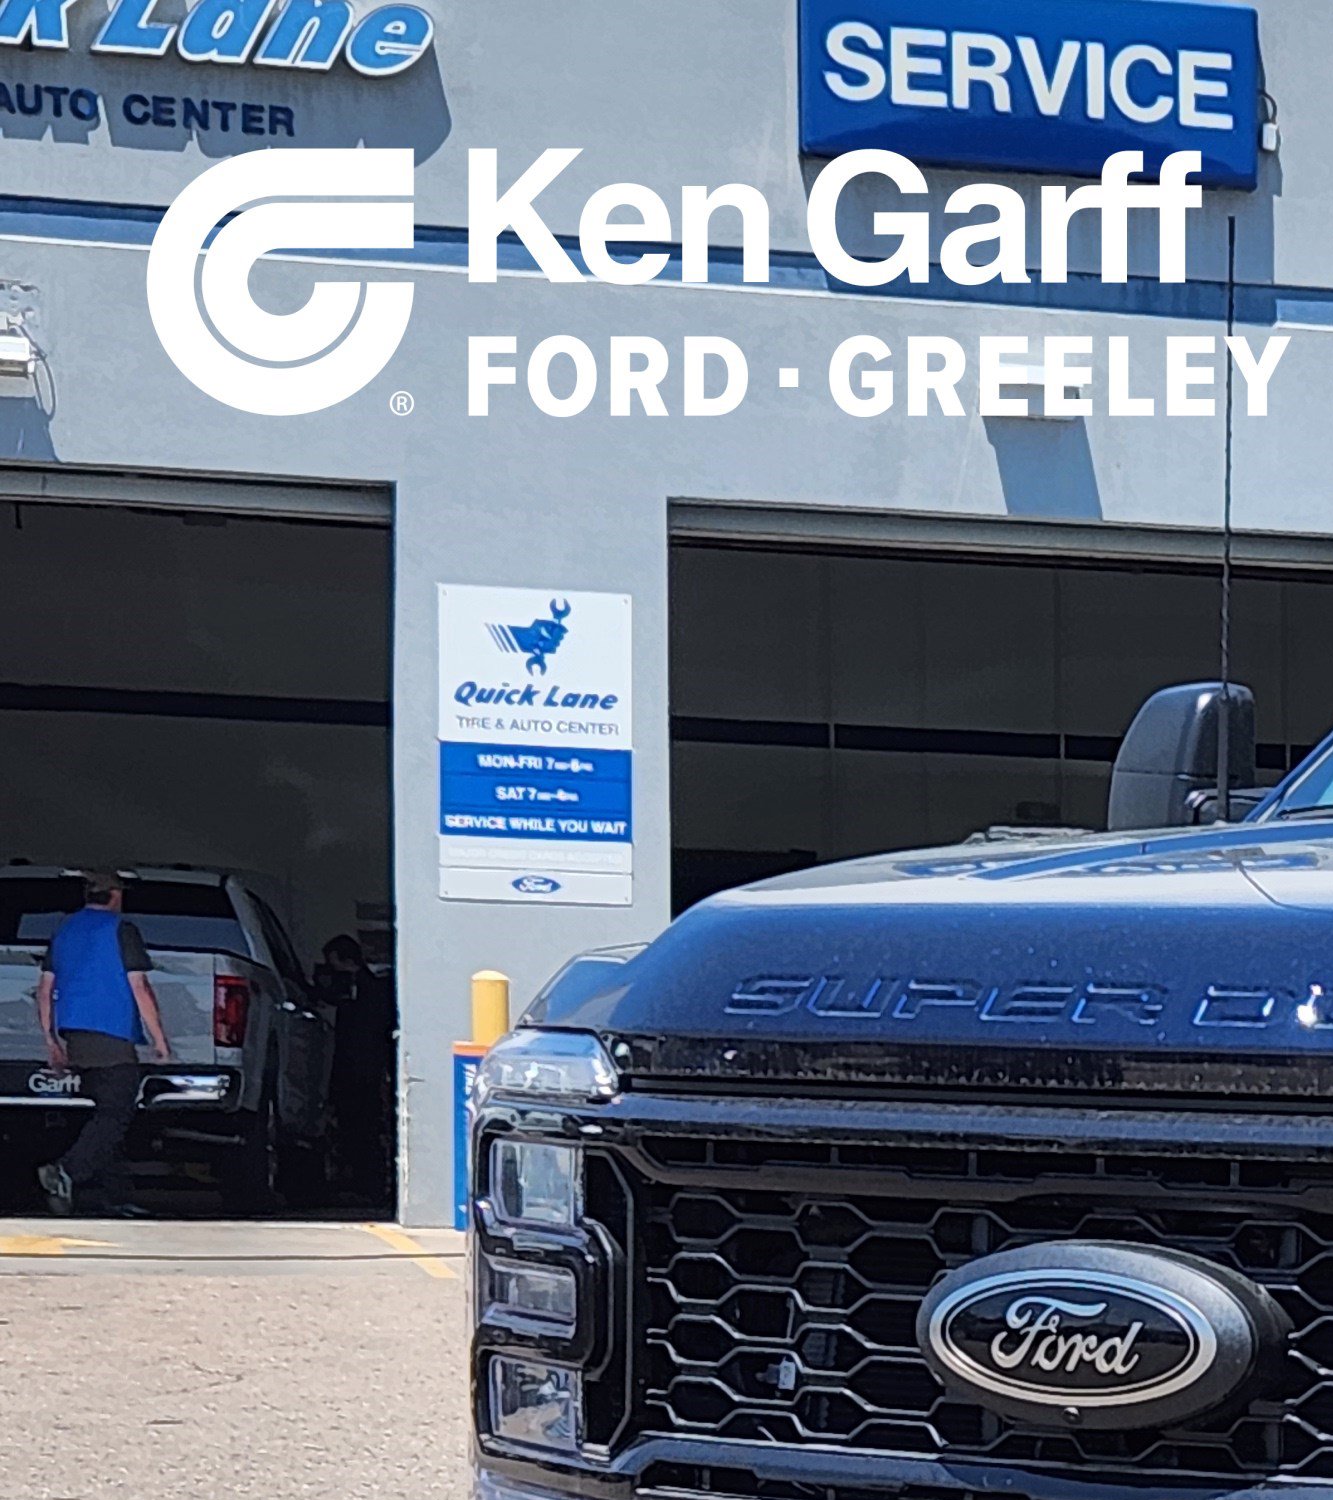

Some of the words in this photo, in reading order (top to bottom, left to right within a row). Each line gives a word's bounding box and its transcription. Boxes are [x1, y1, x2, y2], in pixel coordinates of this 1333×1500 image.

[91, 0, 435, 76] Lane
[824, 21, 1234, 131] SERVICE
[122, 93, 296, 138] CENTER
[453, 681, 540, 707] Quick
[543, 685, 619, 710] Lane
[456, 715, 492, 730] TIRE
[495, 718, 505, 730] &
[510, 719, 553, 733] AUTO
[556, 720, 620, 736] CENTER
[476, 754, 543, 770] MON-FRI
[495, 786, 526, 801] SAT
[444, 814, 507, 831] SERVICE
[508, 816, 557, 833] WHILE
[558, 818, 588, 834] YOU
[590, 820, 628, 836] WAIT
[723, 973, 1168, 1026] SUPER
[991, 1296, 1143, 1375] Ford
